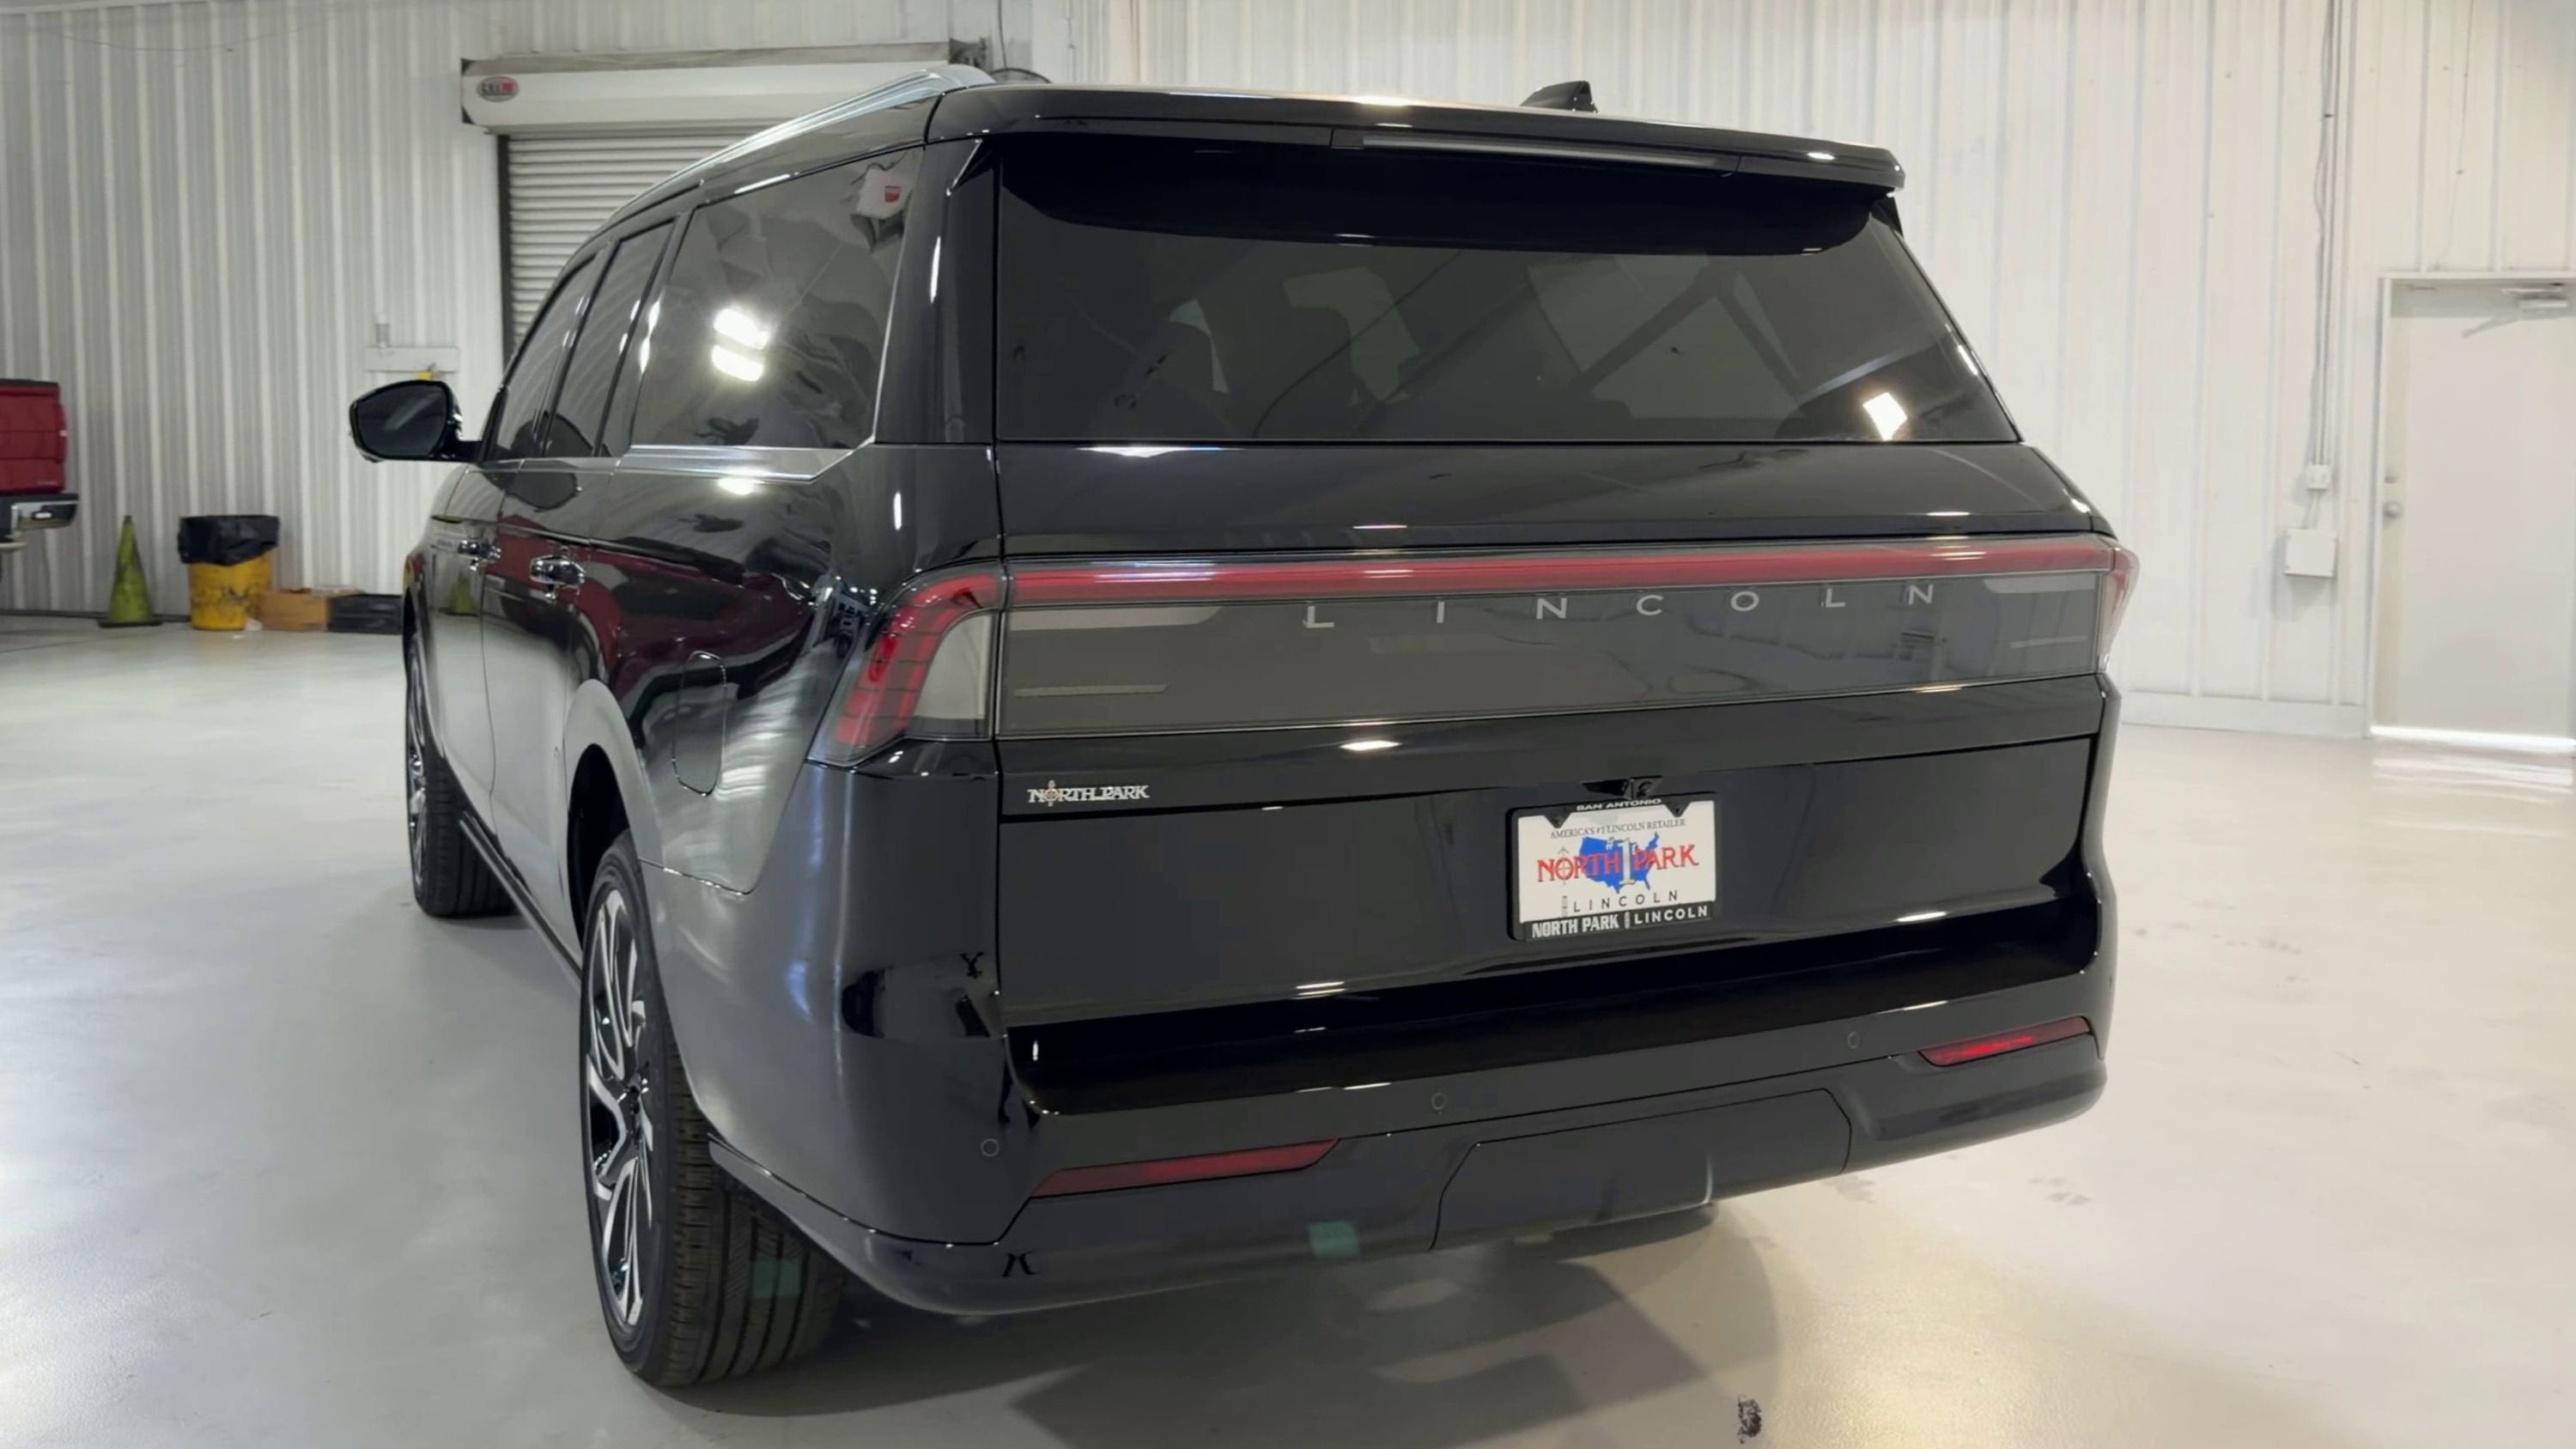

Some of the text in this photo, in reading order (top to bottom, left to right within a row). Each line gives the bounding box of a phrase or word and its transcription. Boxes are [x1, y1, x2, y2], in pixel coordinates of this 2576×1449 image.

[1304, 583, 1934, 629] LINCOLN
[1026, 785, 1151, 804] NORTH PARK
[1577, 798, 1662, 811] SAN ANTONIO
[1550, 826, 1595, 839] AMERICA'S
[1607, 821, 1646, 834] LINCOLN
[1647, 818, 1686, 830] RETAILER
[1536, 844, 1700, 883] NORTH PARK
[1574, 890, 1678, 913] LINCOLN
[1532, 906, 1708, 938] NORTH PARK LINCOLN
